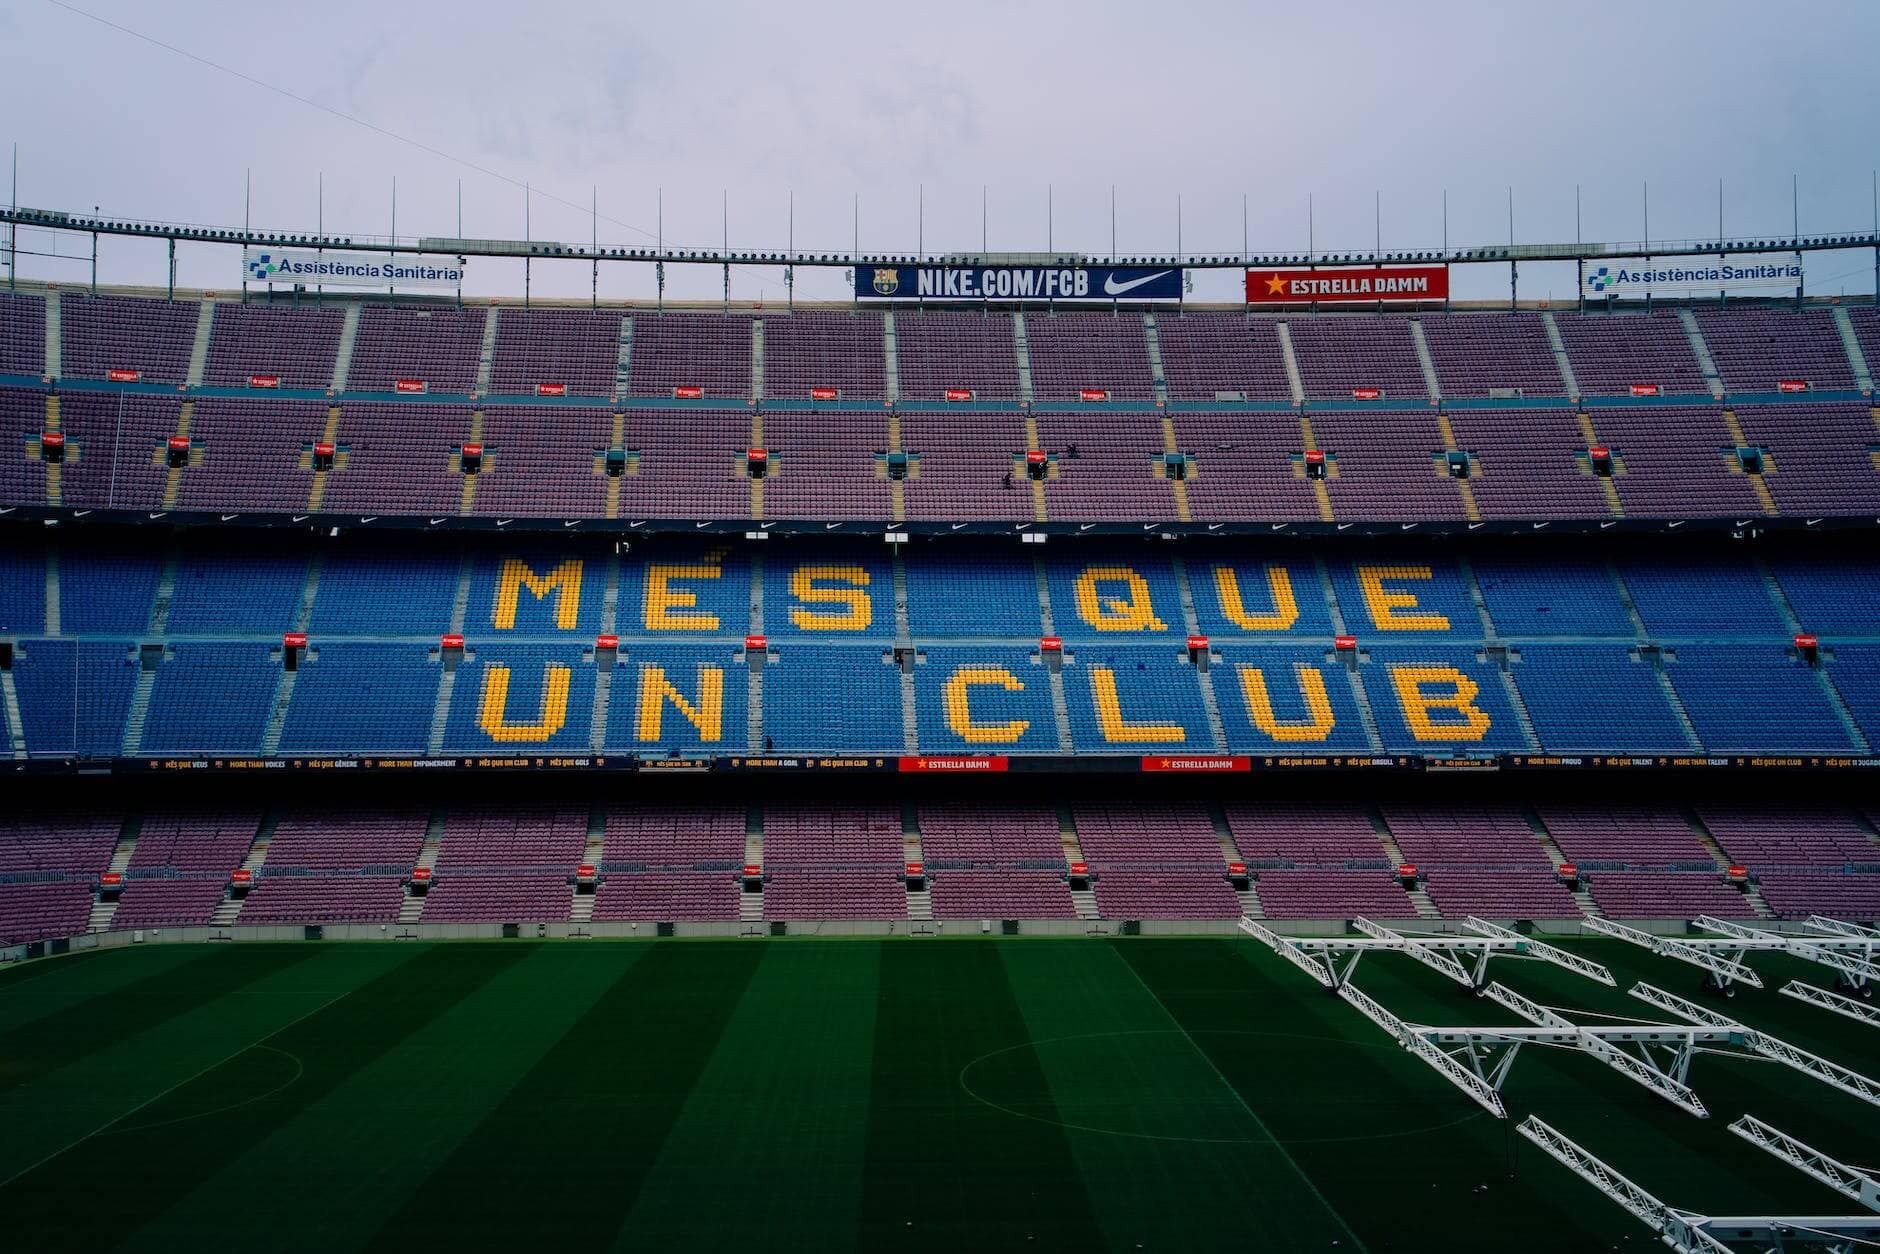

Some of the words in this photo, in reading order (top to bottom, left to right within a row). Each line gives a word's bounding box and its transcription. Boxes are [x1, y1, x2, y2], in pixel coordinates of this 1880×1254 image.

[279, 258, 379, 277] Assistència
[382, 264, 461, 280] Sanitària
[1616, 267, 1719, 283] Assistència
[1721, 263, 1801, 280] Sanitària
[918, 269, 1089, 296] NIKE.COM/FCB
[1290, 278, 1372, 295] ESTRELLA
[1374, 277, 1428, 292] DAMM
[493, 546, 873, 631] MÉS
[1075, 566, 1450, 631] QUE
[477, 664, 724, 742] UN
[944, 665, 1491, 742] CLUB
